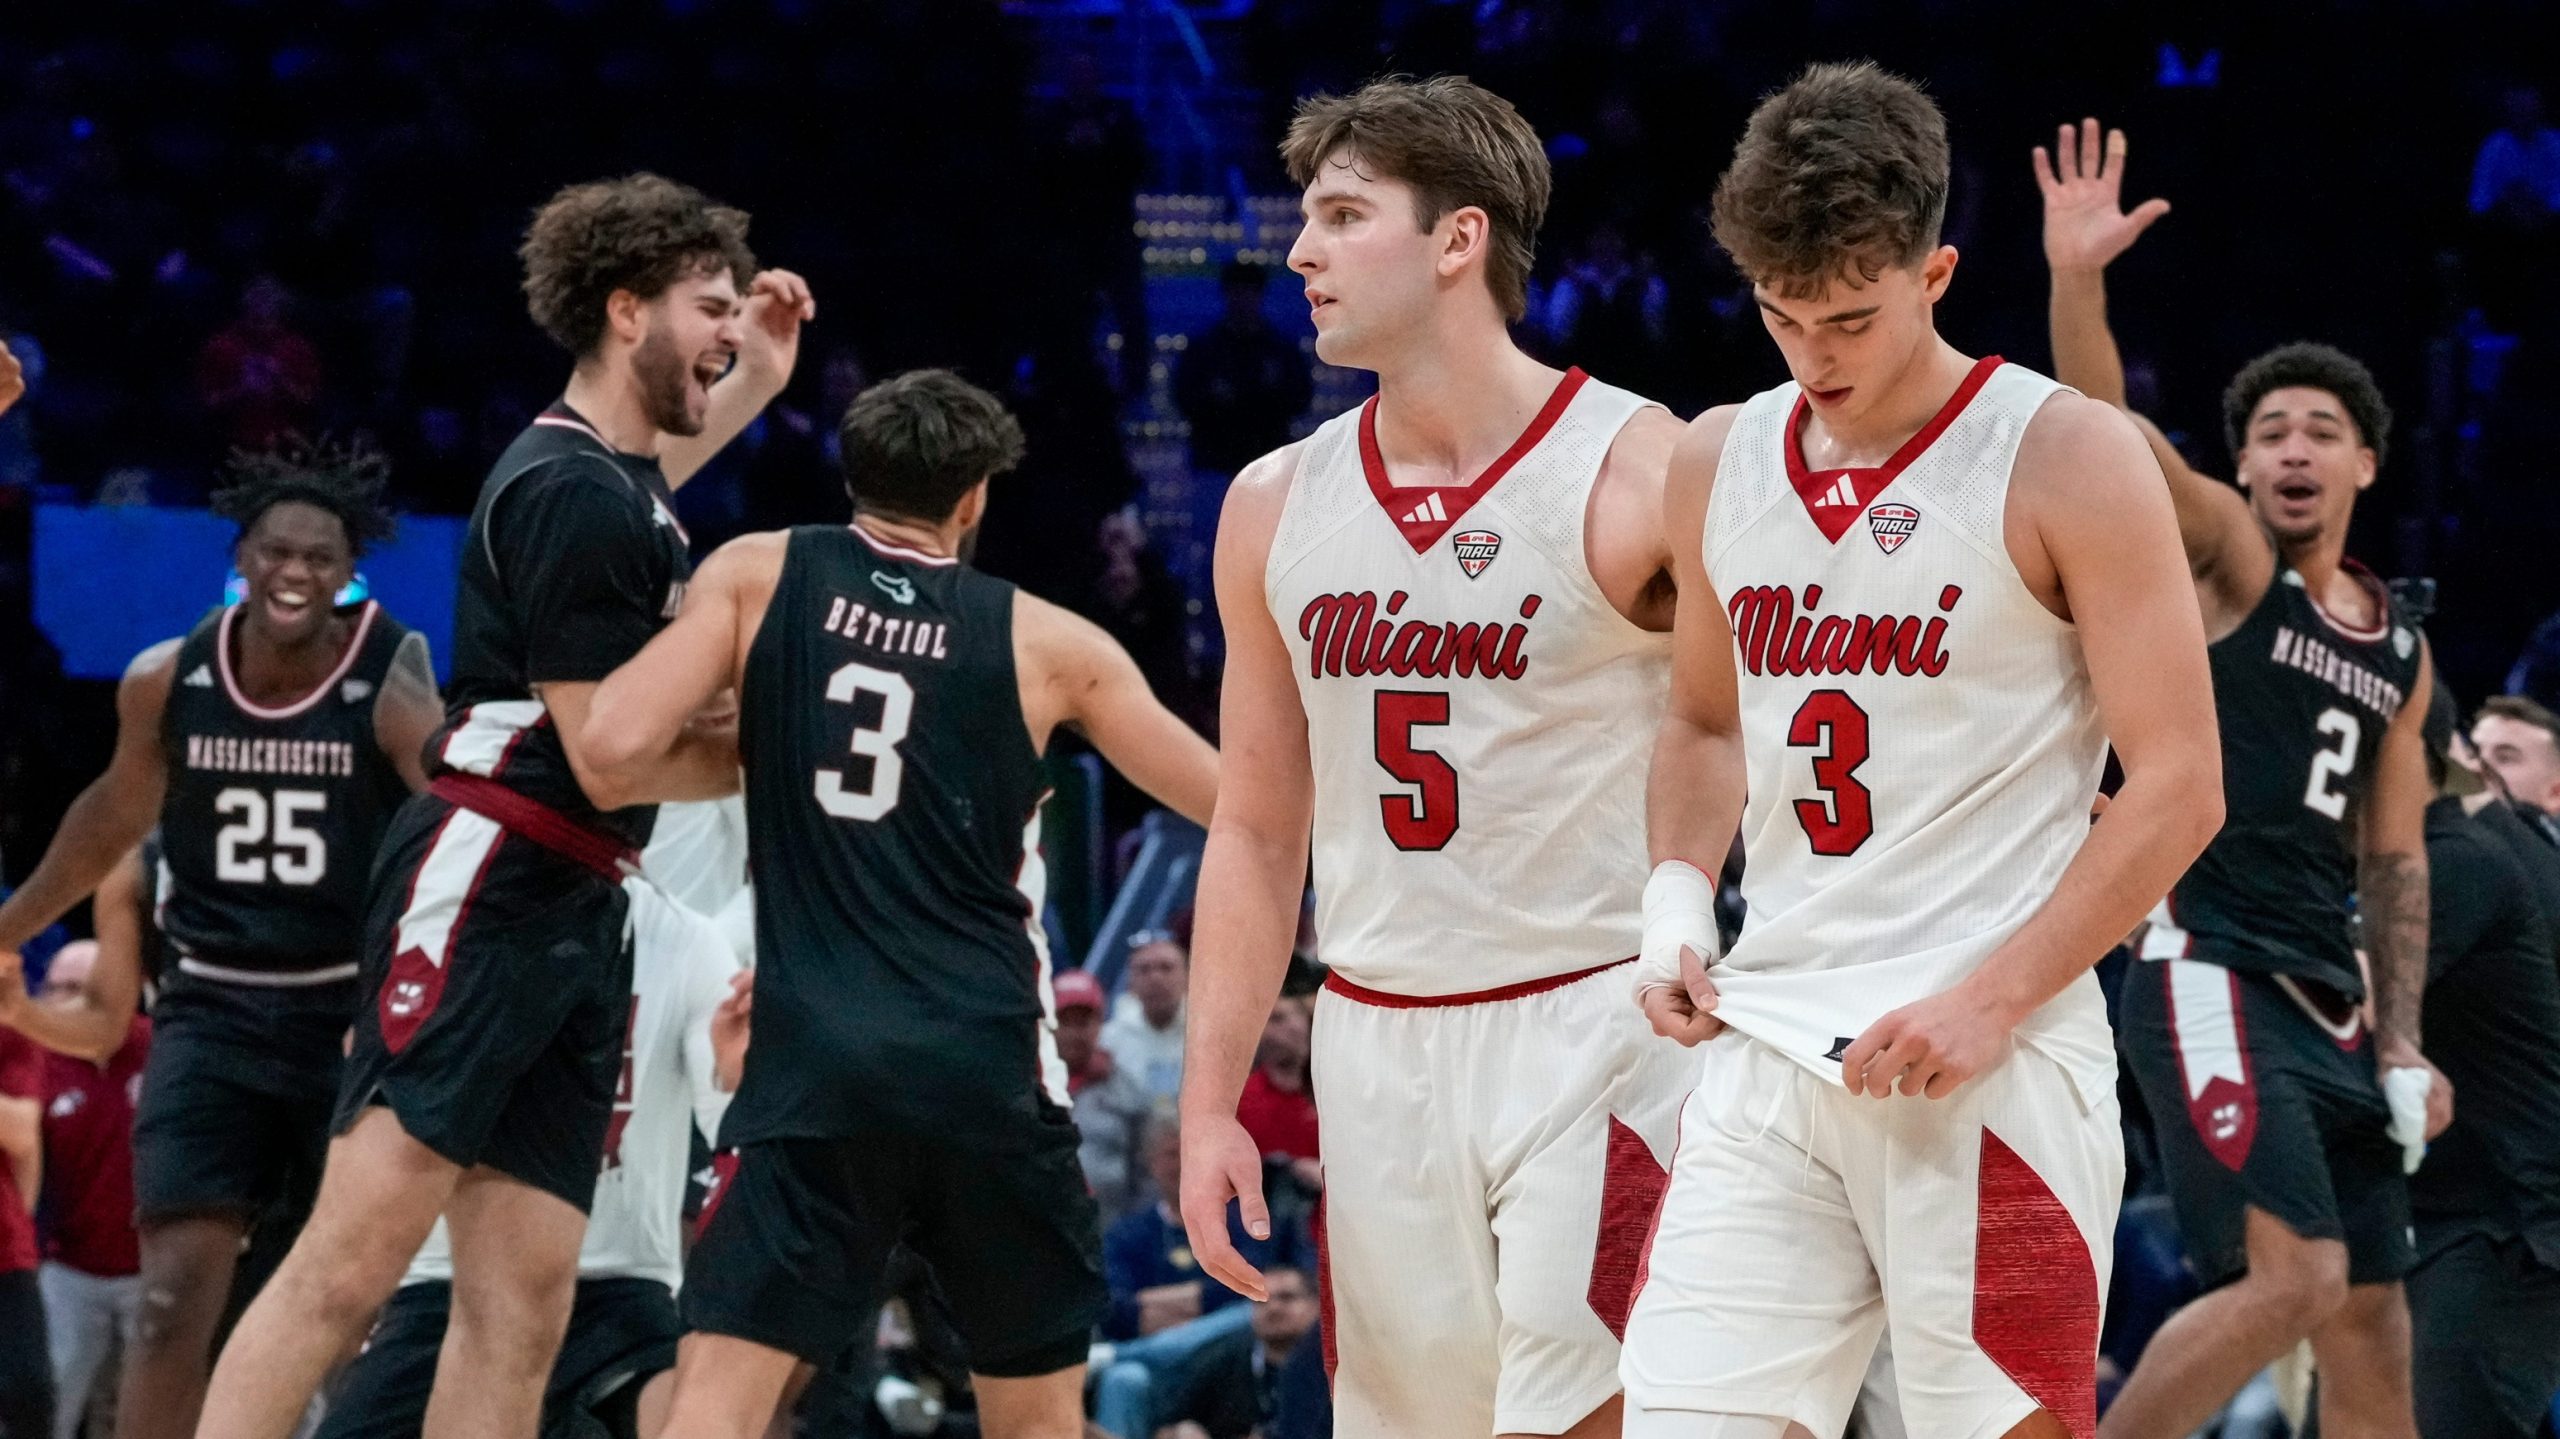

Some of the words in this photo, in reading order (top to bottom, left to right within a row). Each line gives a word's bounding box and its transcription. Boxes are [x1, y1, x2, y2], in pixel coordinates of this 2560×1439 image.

[1457, 545, 1498, 558] MAC
[1871, 519, 1916, 533] MAC
[824, 596, 947, 660] BETTIOL
[1299, 590, 1542, 680] Miami
[1728, 584, 1962, 677] Miami
[187, 735, 353, 776] MASSACHUSETTS
[814, 662, 914, 822] 3
[1374, 689, 1459, 851] 5
[1787, 689, 1873, 857] 3
[2304, 707, 2361, 821] 2
[215, 787, 327, 885] 25
